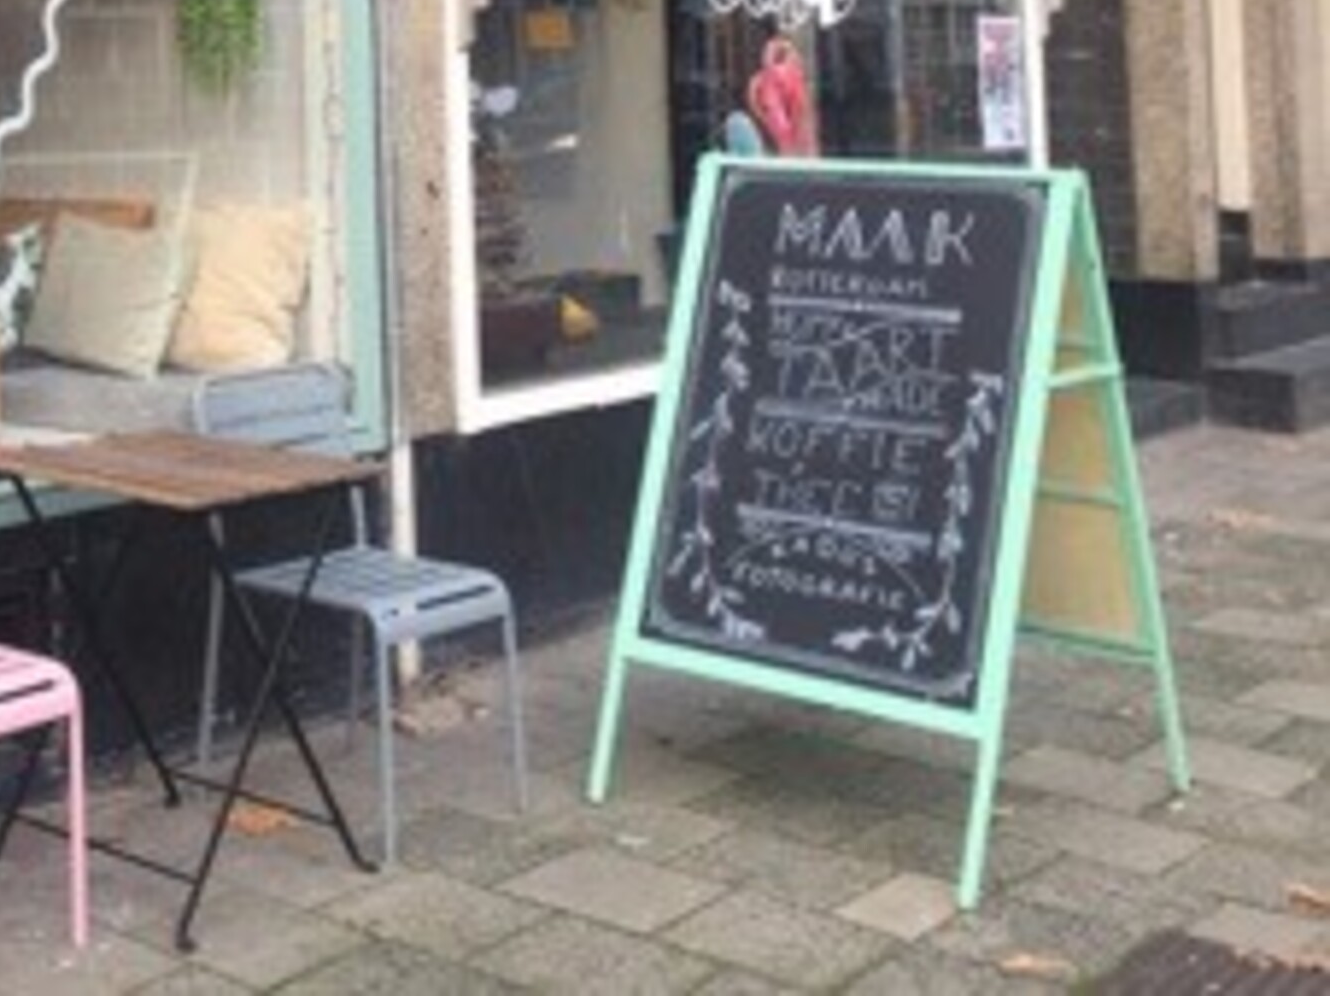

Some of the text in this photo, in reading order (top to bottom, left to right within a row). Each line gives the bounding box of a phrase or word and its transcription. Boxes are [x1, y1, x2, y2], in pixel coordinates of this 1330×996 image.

[774, 202, 974, 266] MAAK
[771, 264, 928, 300] ROTTERDAM
[745, 416, 928, 474] KOFFIE
[732, 560, 906, 610] FOTOGRAFIE
